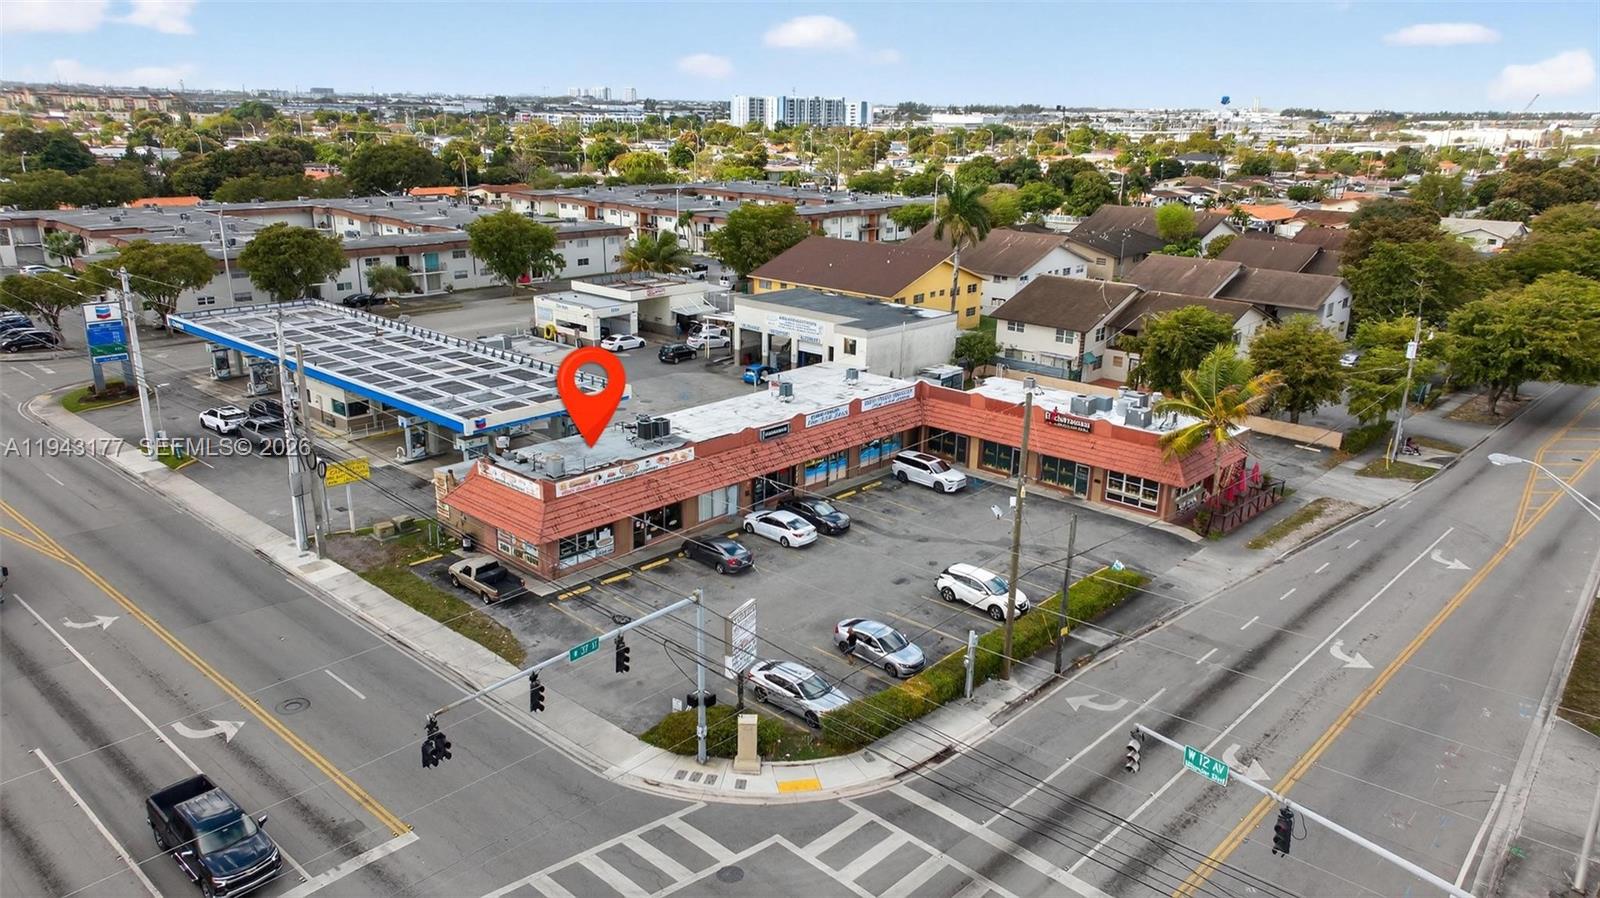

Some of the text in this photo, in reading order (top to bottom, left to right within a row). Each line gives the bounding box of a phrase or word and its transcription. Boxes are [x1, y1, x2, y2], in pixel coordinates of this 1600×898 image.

[1188, 748, 1196, 761] W
[1199, 754, 1210, 769] 12
[1212, 762, 1225, 774] AV
